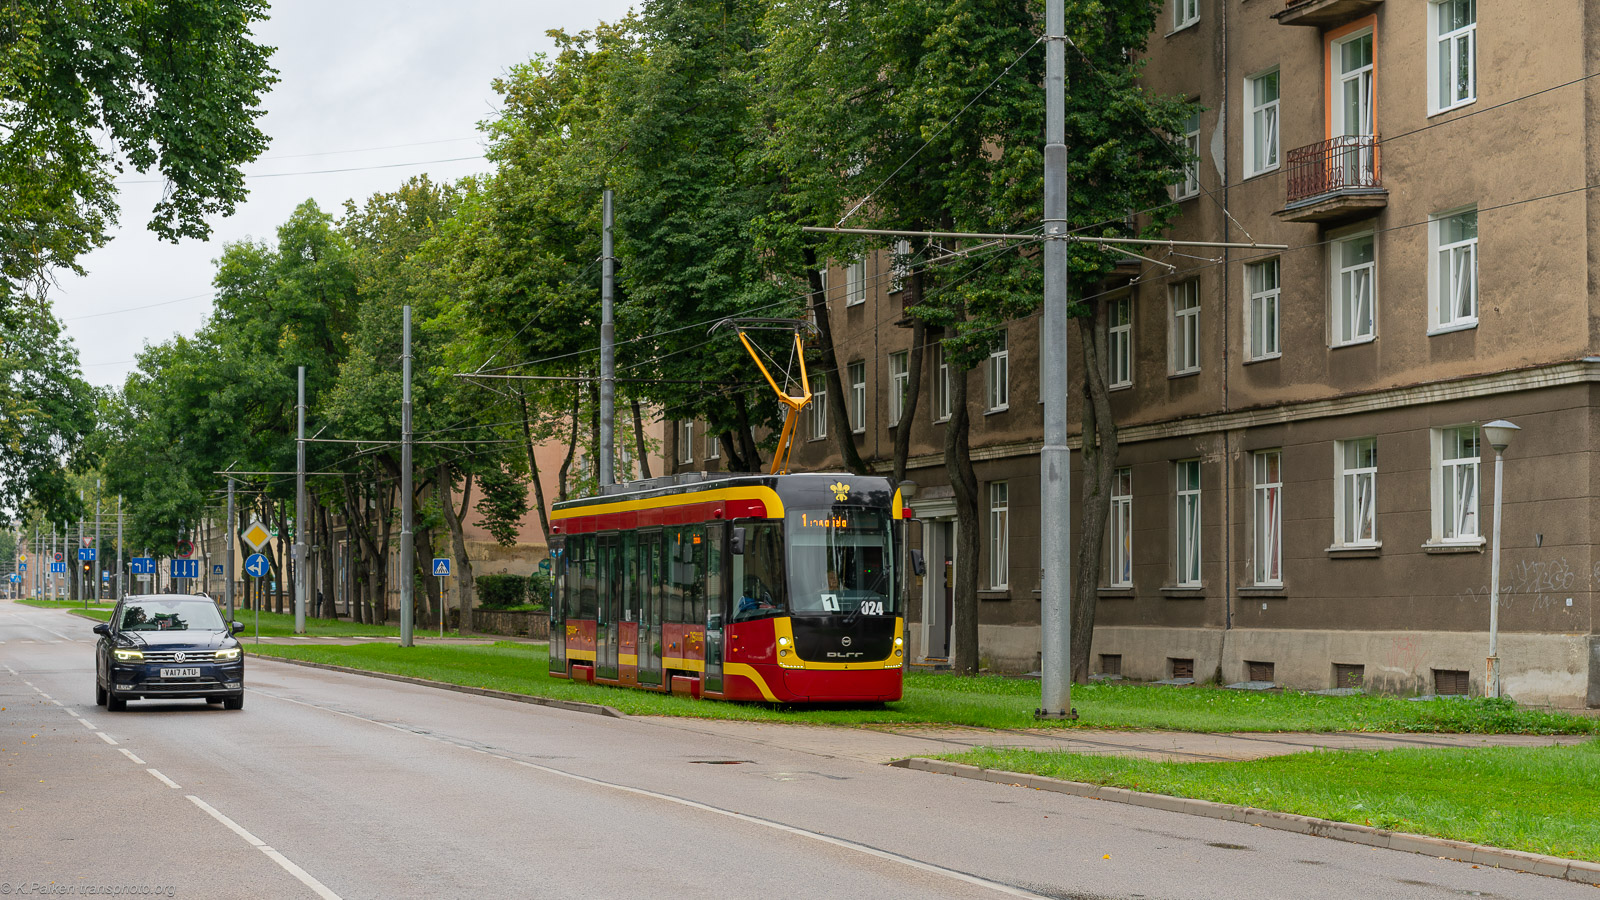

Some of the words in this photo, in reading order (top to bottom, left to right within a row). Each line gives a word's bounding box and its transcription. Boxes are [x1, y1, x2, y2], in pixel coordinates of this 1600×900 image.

[801, 513, 807, 527] 1
[825, 596, 835, 609] 1
[861, 601, 883, 615] 024
